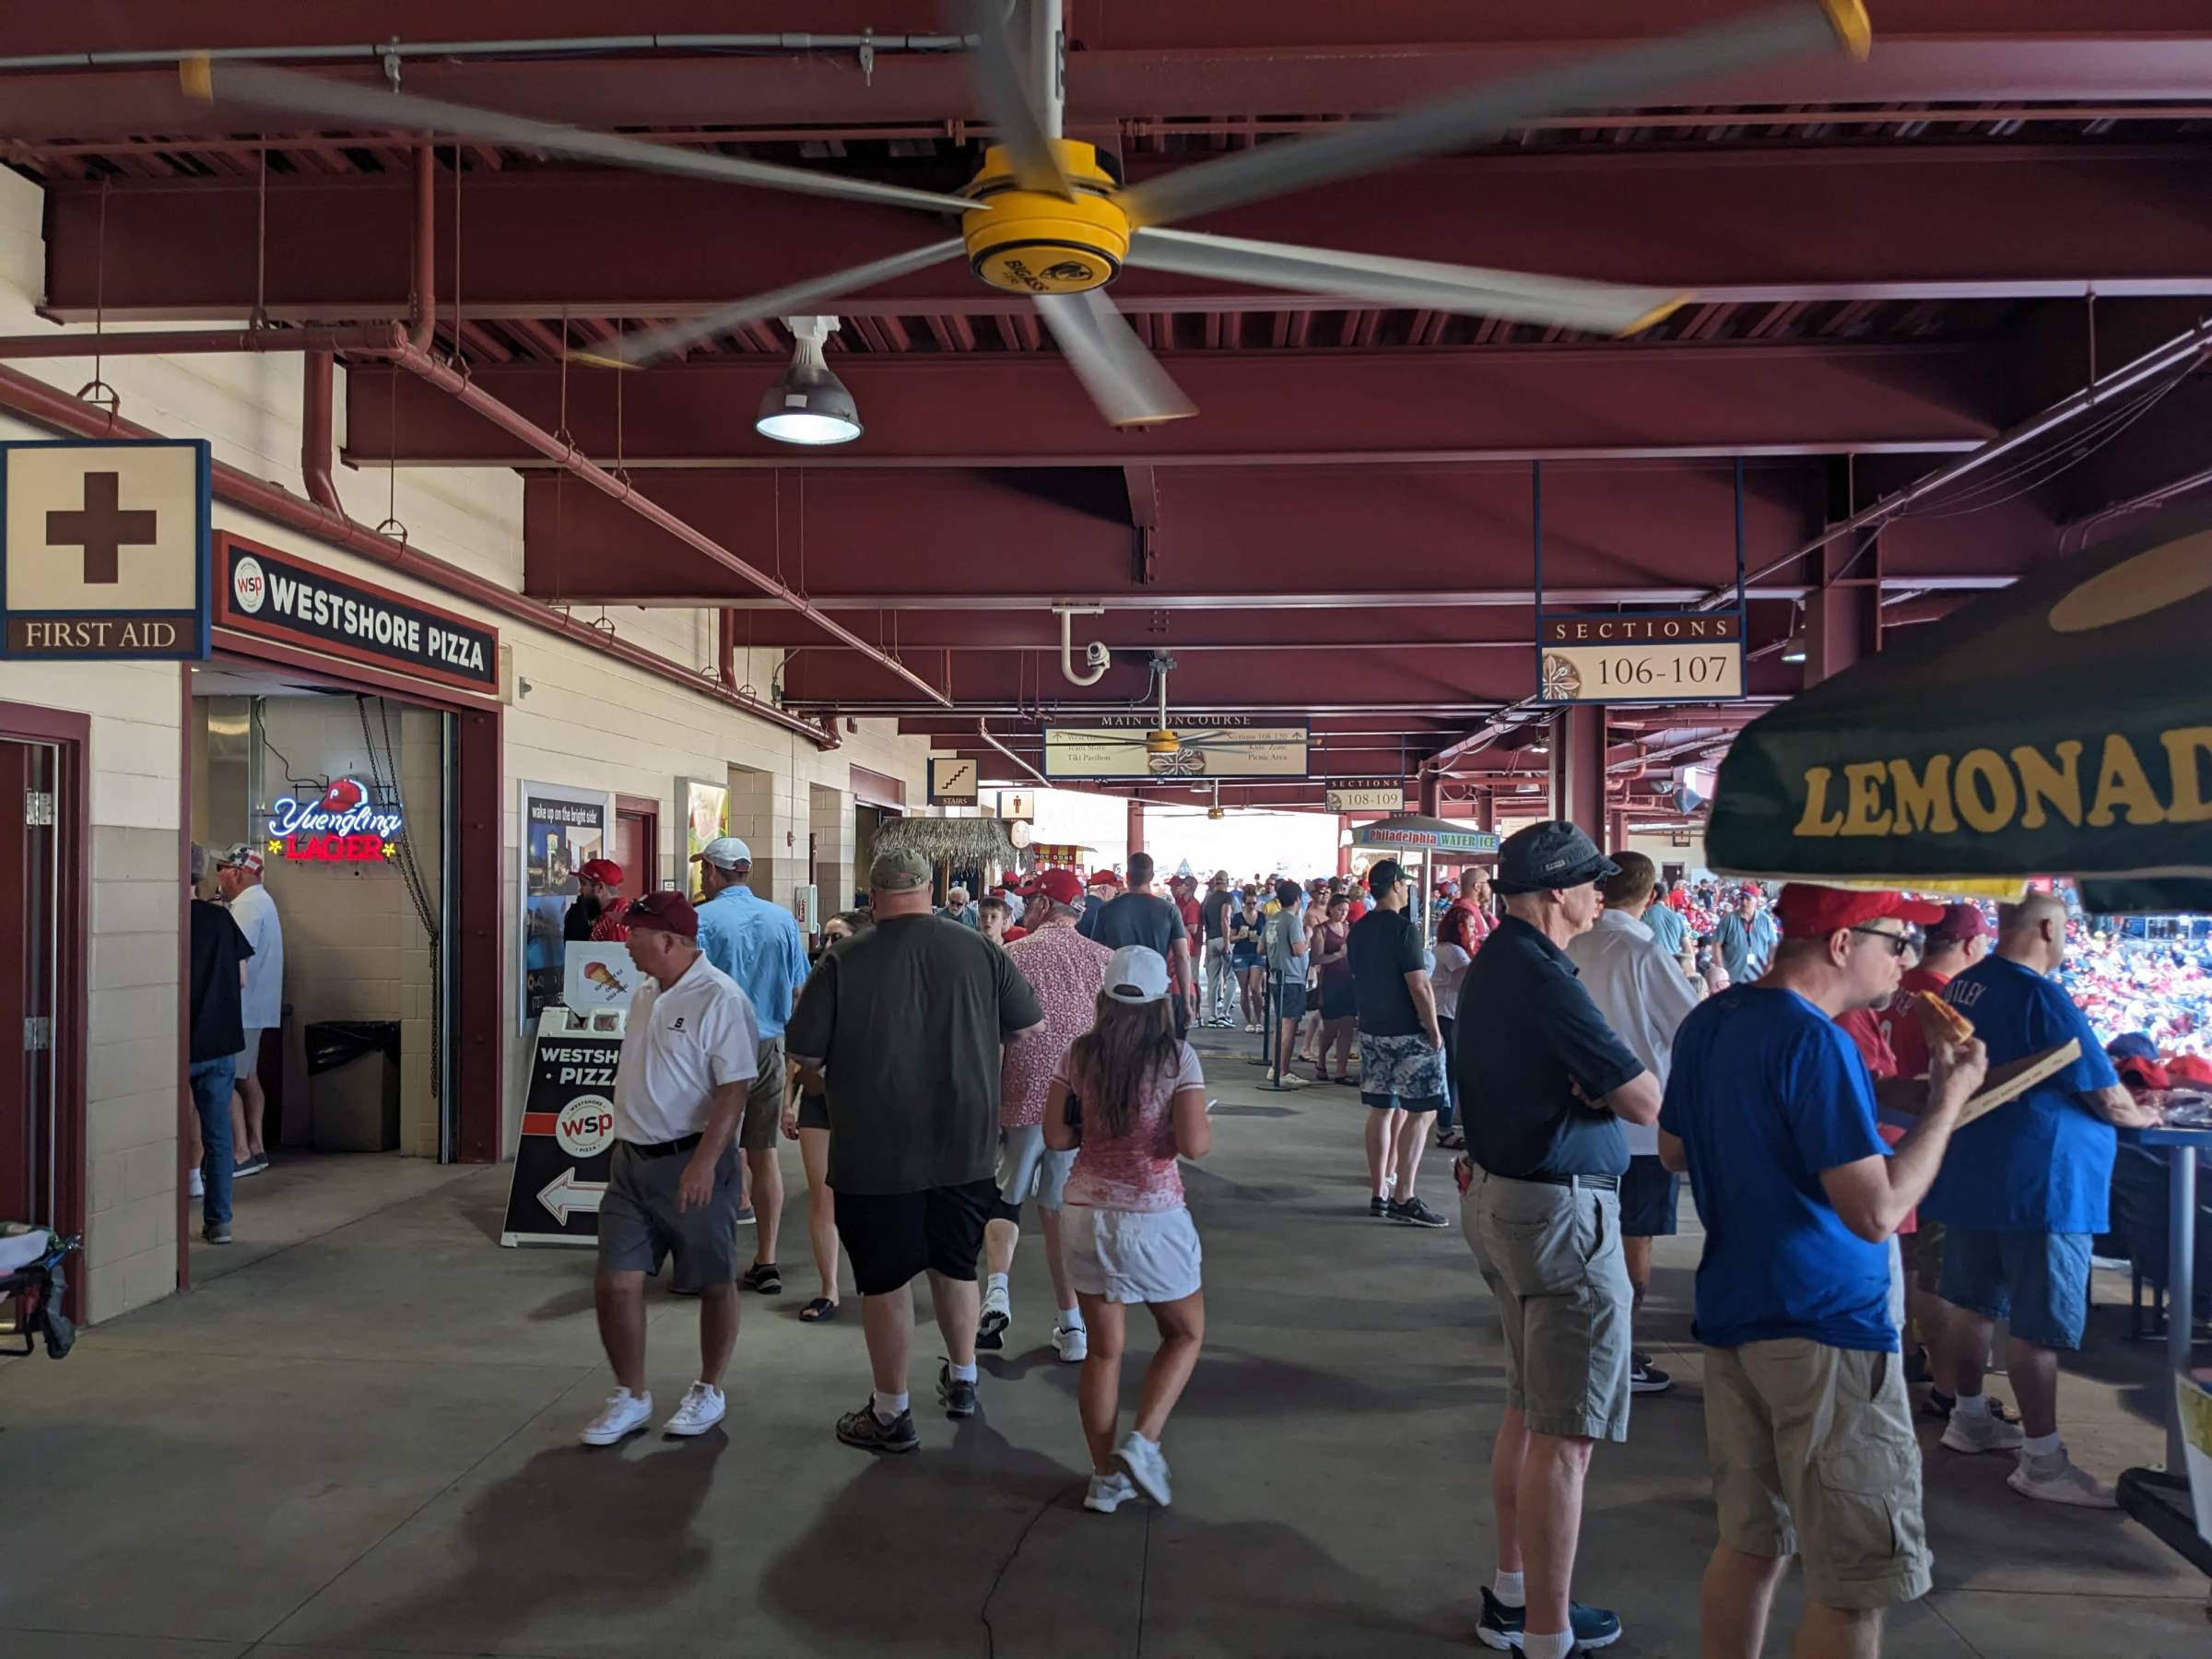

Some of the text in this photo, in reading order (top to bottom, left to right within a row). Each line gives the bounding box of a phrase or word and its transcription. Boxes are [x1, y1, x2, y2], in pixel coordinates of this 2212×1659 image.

[237, 575, 263, 597] wsp
[268, 572, 484, 672] WESTSHORE PIZZA
[1556, 620, 1727, 639] SECTIONS
[26, 622, 176, 647] FIRST AID
[1598, 655, 1727, 685] 106-107
[1101, 716, 1251, 726] MAIN CONCOURSE
[1793, 726, 2212, 837] LEMONAD
[1348, 794, 1397, 805] 108-109
[268, 797, 402, 838] Yuengling
[532, 804, 547, 818] wake
[547, 808, 555, 824] up
[555, 809, 562, 820] on
[562, 806, 571, 821] the
[571, 806, 586, 825] bright
[285, 834, 384, 863] LAGER
[1370, 829, 1496, 848] Philadelphia WATER ICE
[541, 1047, 619, 1065] WESTSH
[561, 1113, 613, 1137] wsp
